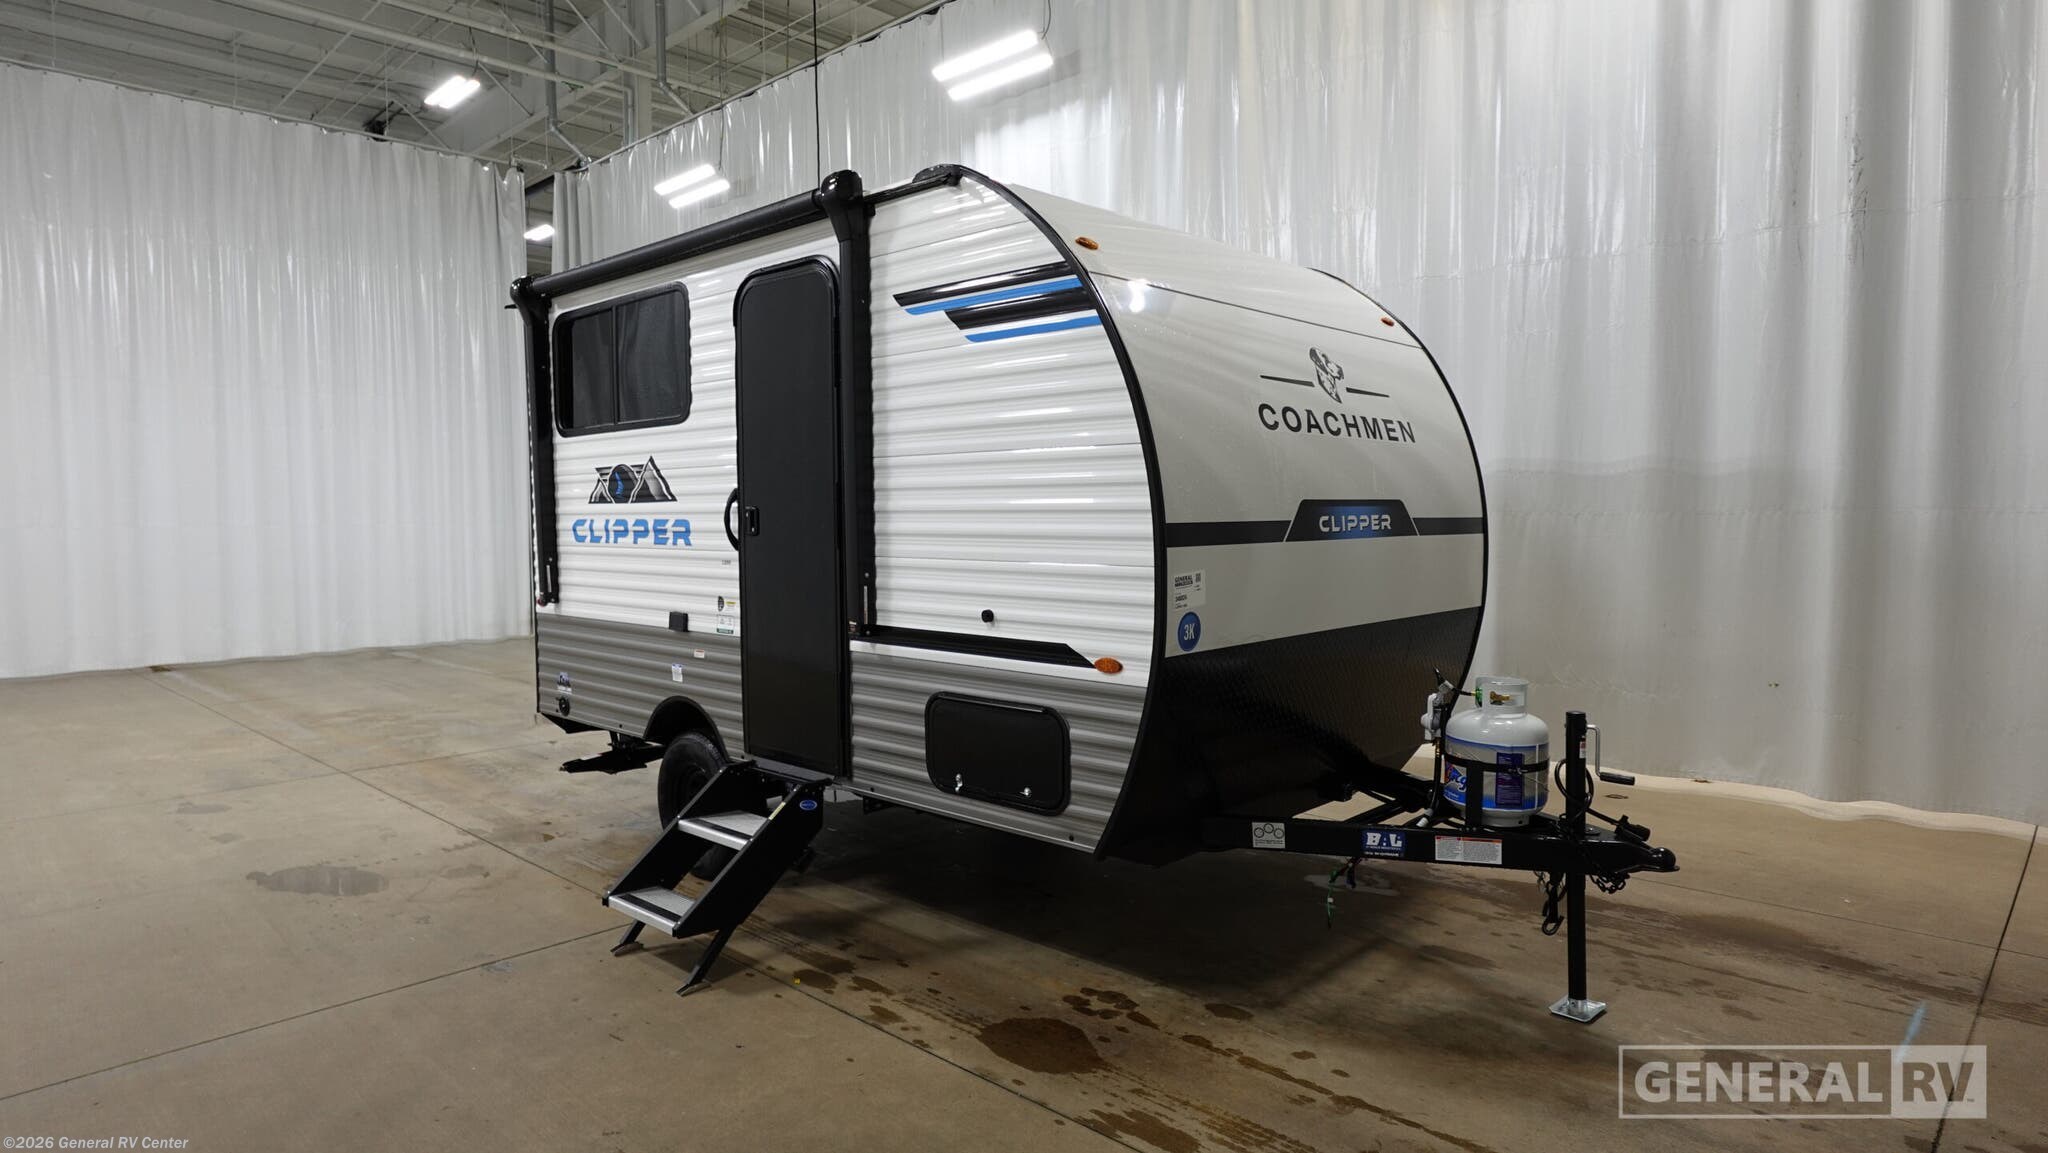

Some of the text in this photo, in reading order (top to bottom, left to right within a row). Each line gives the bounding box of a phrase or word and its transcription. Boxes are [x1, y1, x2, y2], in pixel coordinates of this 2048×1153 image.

[1258, 403, 1416, 443] COACHMEN
[571, 519, 692, 546] CLIPPER
[1318, 514, 1392, 532] CLIPPER
[1184, 622, 1195, 640] 3K
